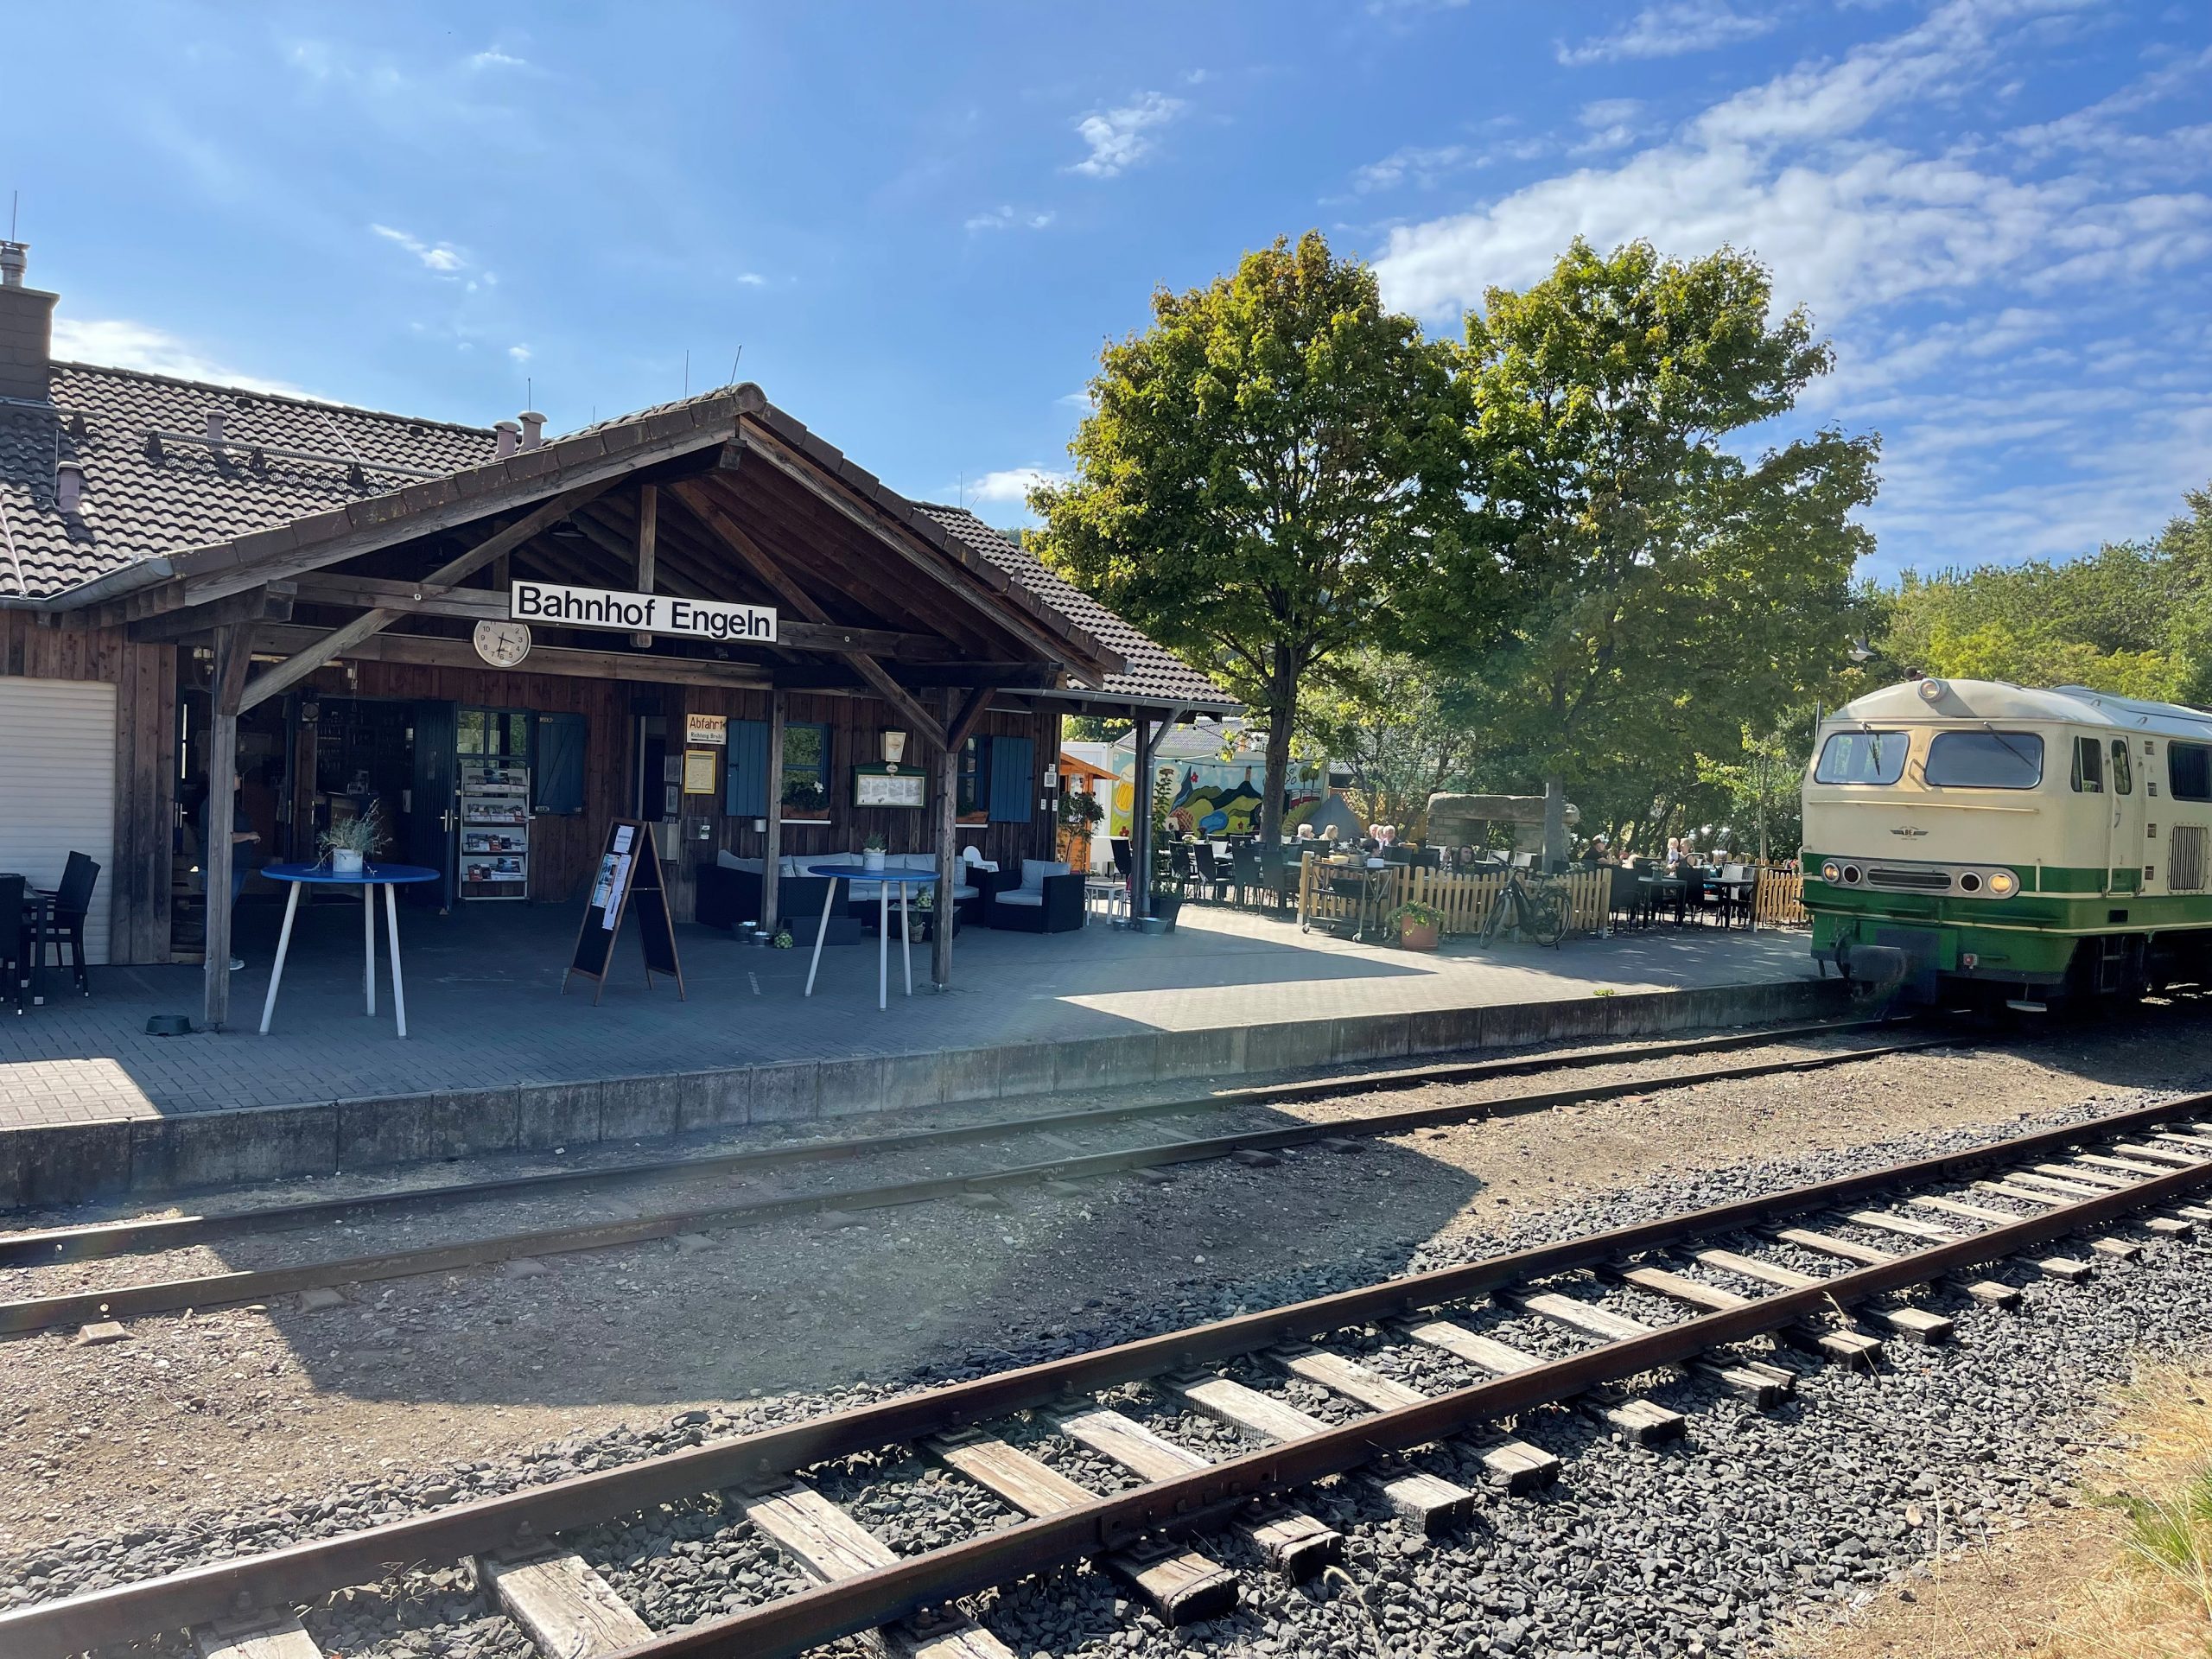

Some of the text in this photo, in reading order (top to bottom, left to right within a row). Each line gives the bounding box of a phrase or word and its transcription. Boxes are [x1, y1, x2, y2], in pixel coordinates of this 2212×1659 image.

[518, 585, 771, 639] Bahnhof Engeln
[690, 717, 723, 730] Abfahrt
